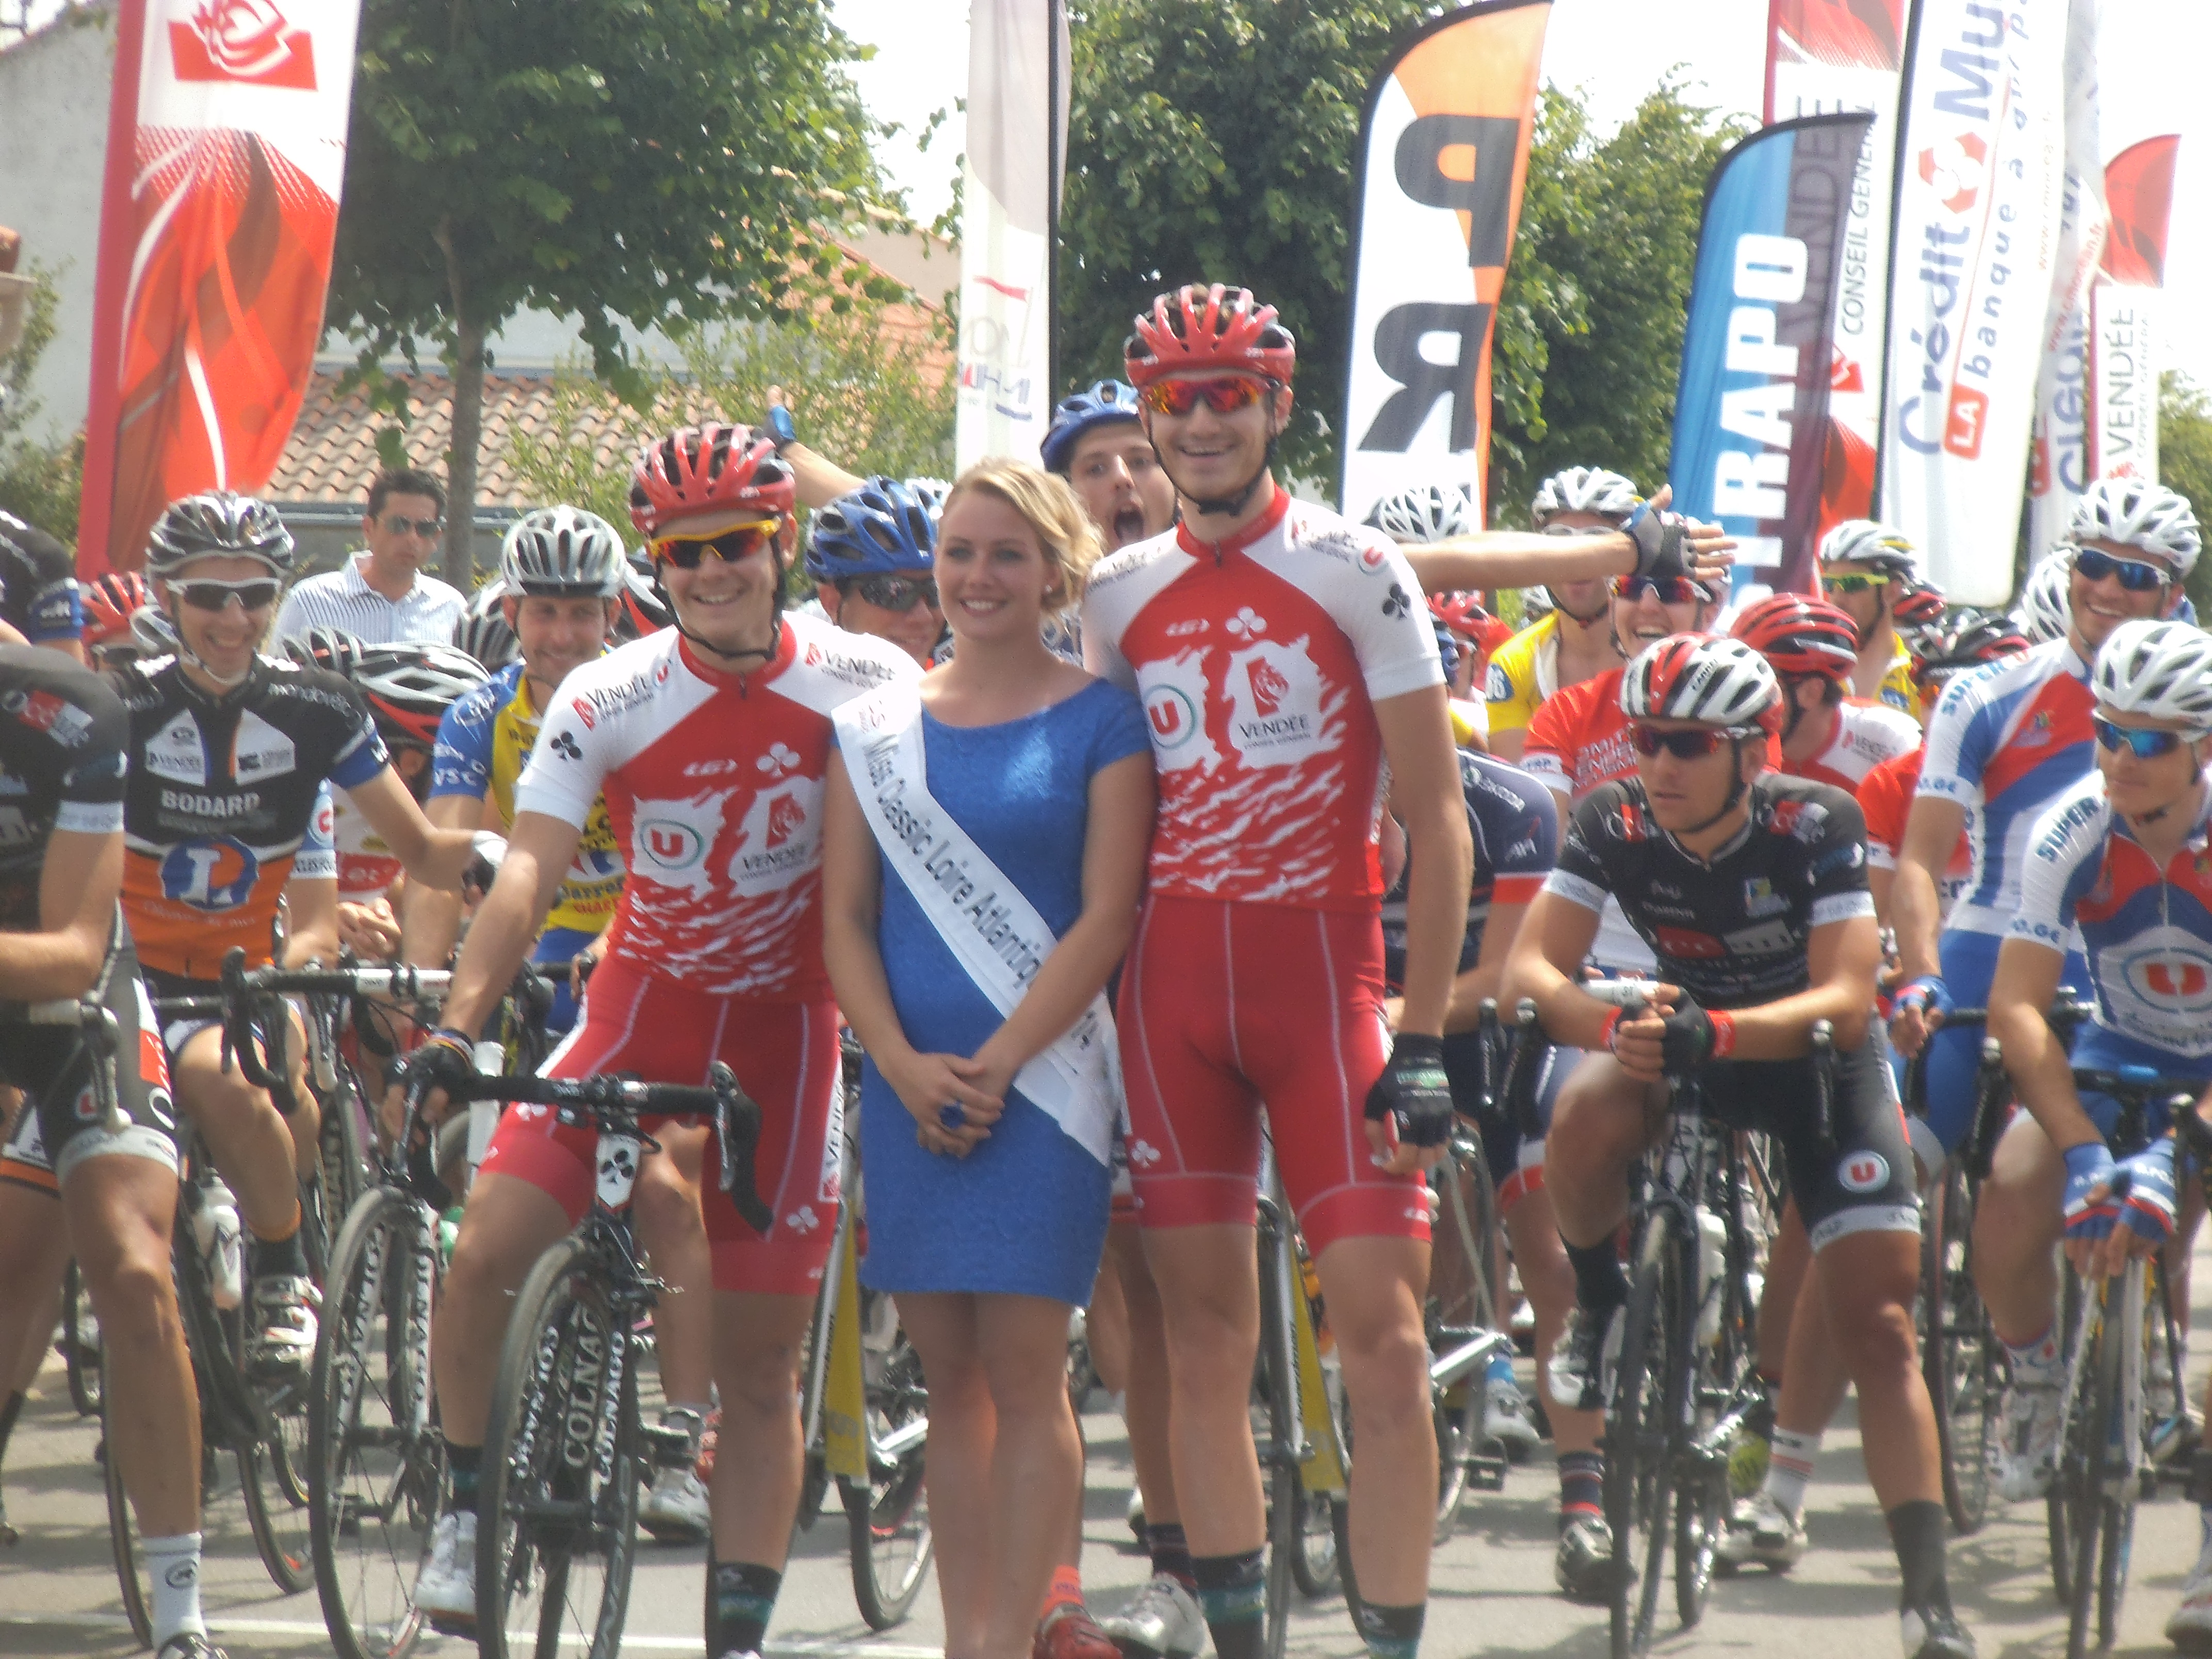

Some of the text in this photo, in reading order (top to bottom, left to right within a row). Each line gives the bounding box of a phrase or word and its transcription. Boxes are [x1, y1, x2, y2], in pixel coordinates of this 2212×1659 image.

[1842, 227, 1869, 335] CONSEIL
[1963, 203, 2017, 379] banque
[1898, 221, 1970, 454] Crédit
[2105, 308, 2135, 457] VENDÉE
[1951, 400, 1981, 449] LA
[1148, 700, 1181, 735] U
[863, 734, 899, 788] Miss
[160, 789, 261, 818] BODARD
[876, 777, 932, 855] Classic
[650, 828, 684, 859] U
[924, 840, 975, 906] Loire
